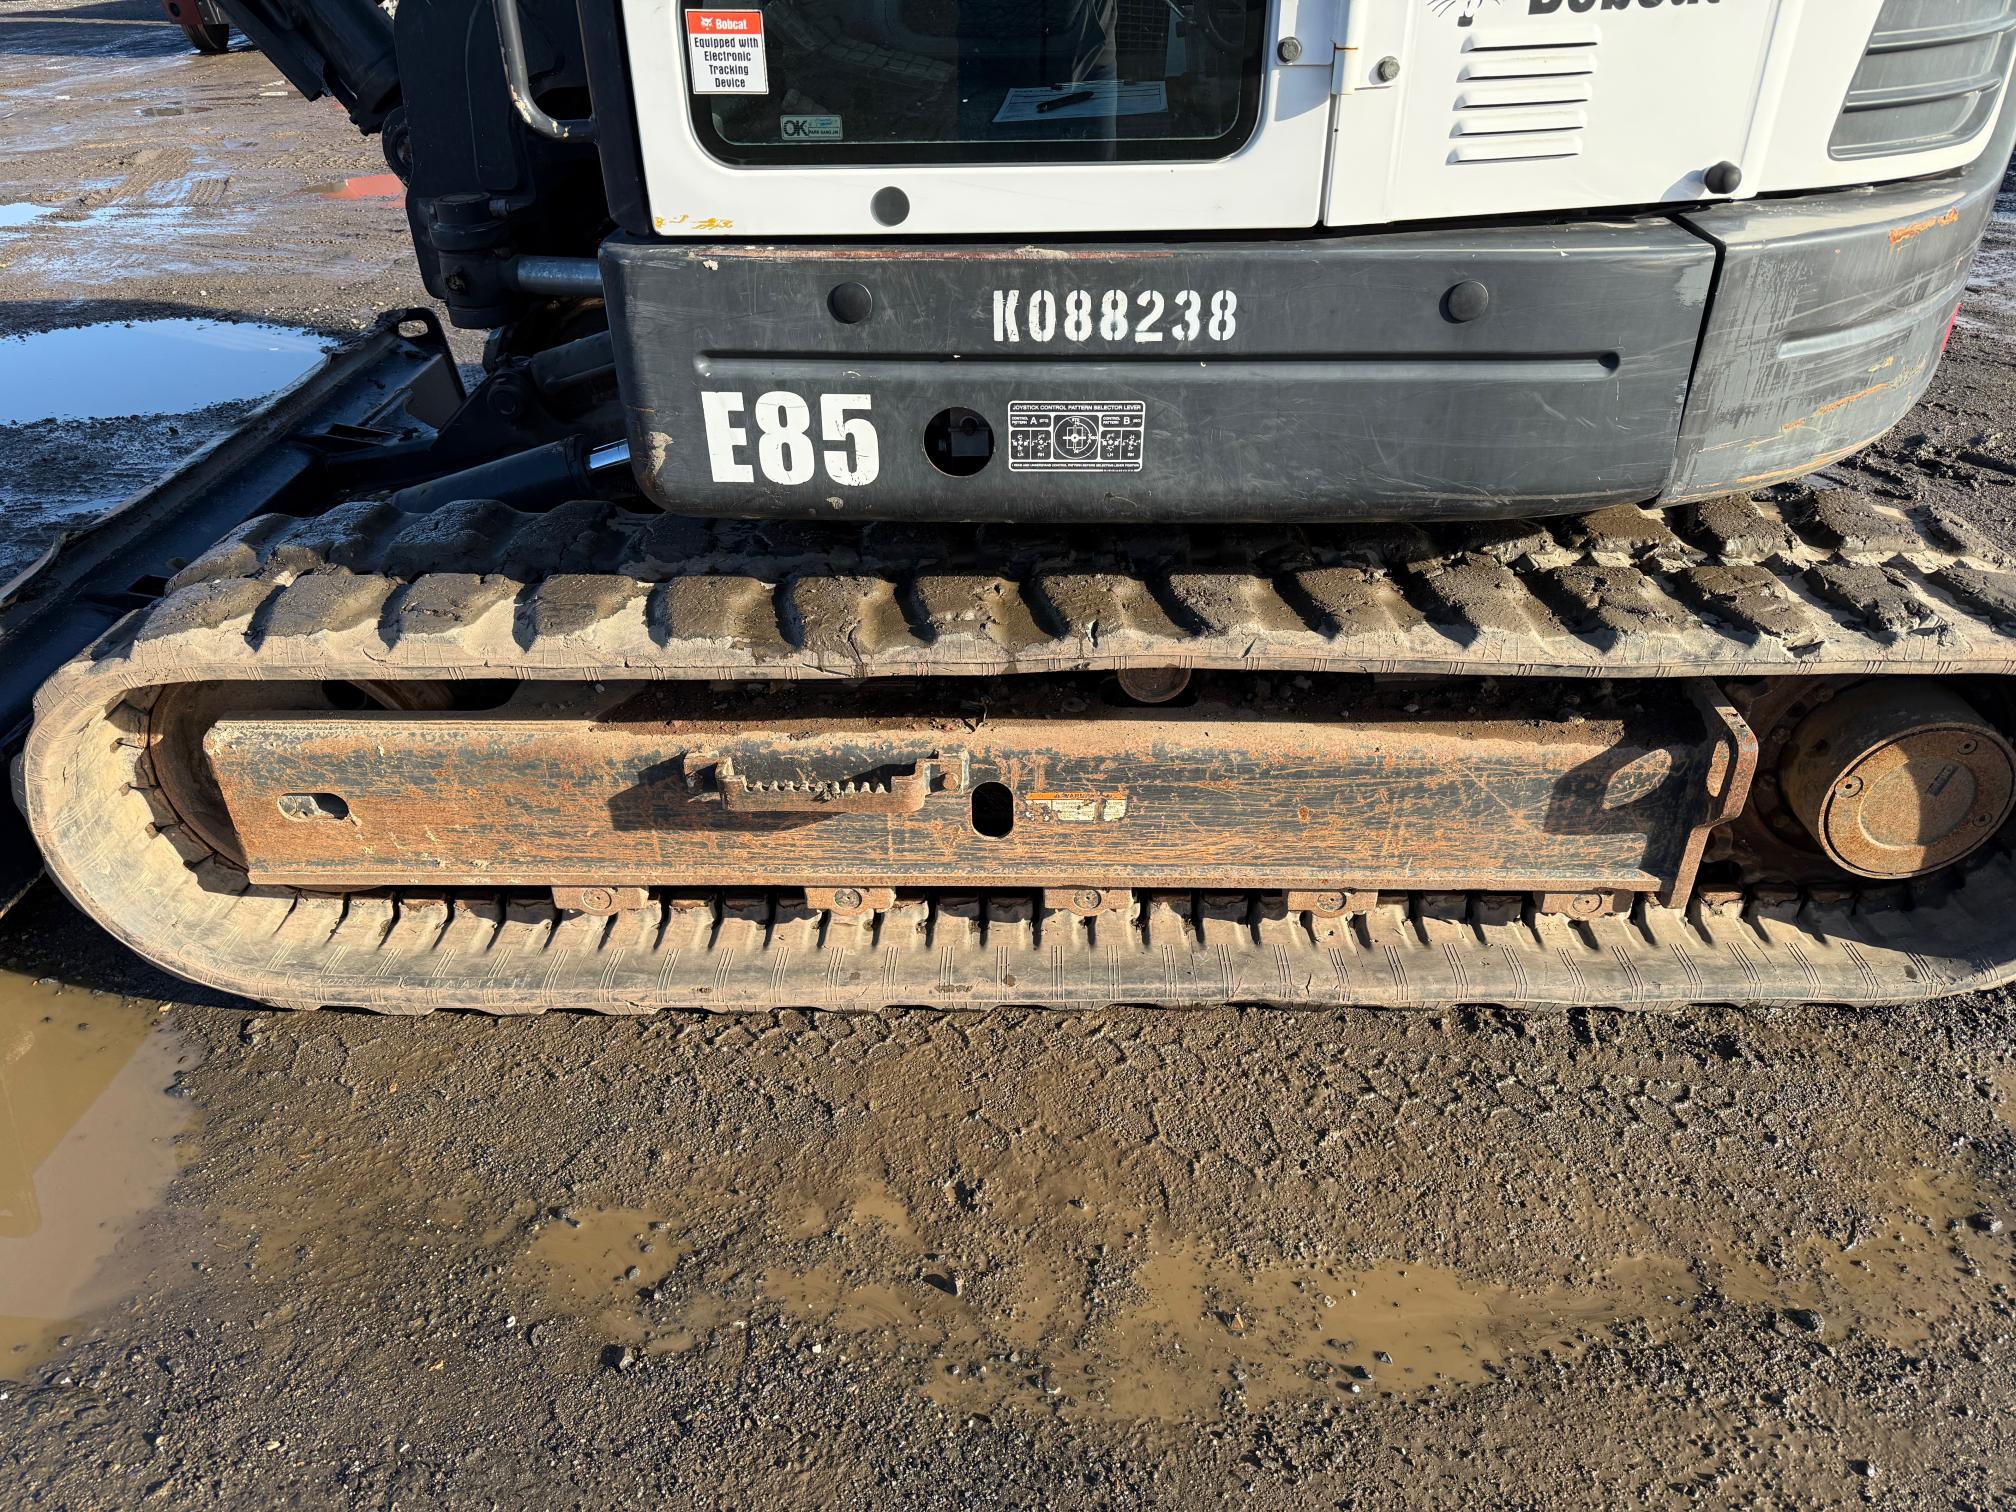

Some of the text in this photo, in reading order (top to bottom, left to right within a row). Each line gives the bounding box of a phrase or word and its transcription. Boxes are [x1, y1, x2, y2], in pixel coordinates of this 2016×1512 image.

[716, 18, 747, 30] Bobcat
[694, 37, 759, 48] Equipped with
[704, 51, 751, 61] Electronic
[709, 64, 749, 75] Tracking
[715, 77, 746, 88] Device
[783, 120, 808, 136] OK
[993, 289, 1238, 343] K088238
[1123, 416, 1130, 424] B
[701, 391, 880, 486] E85
